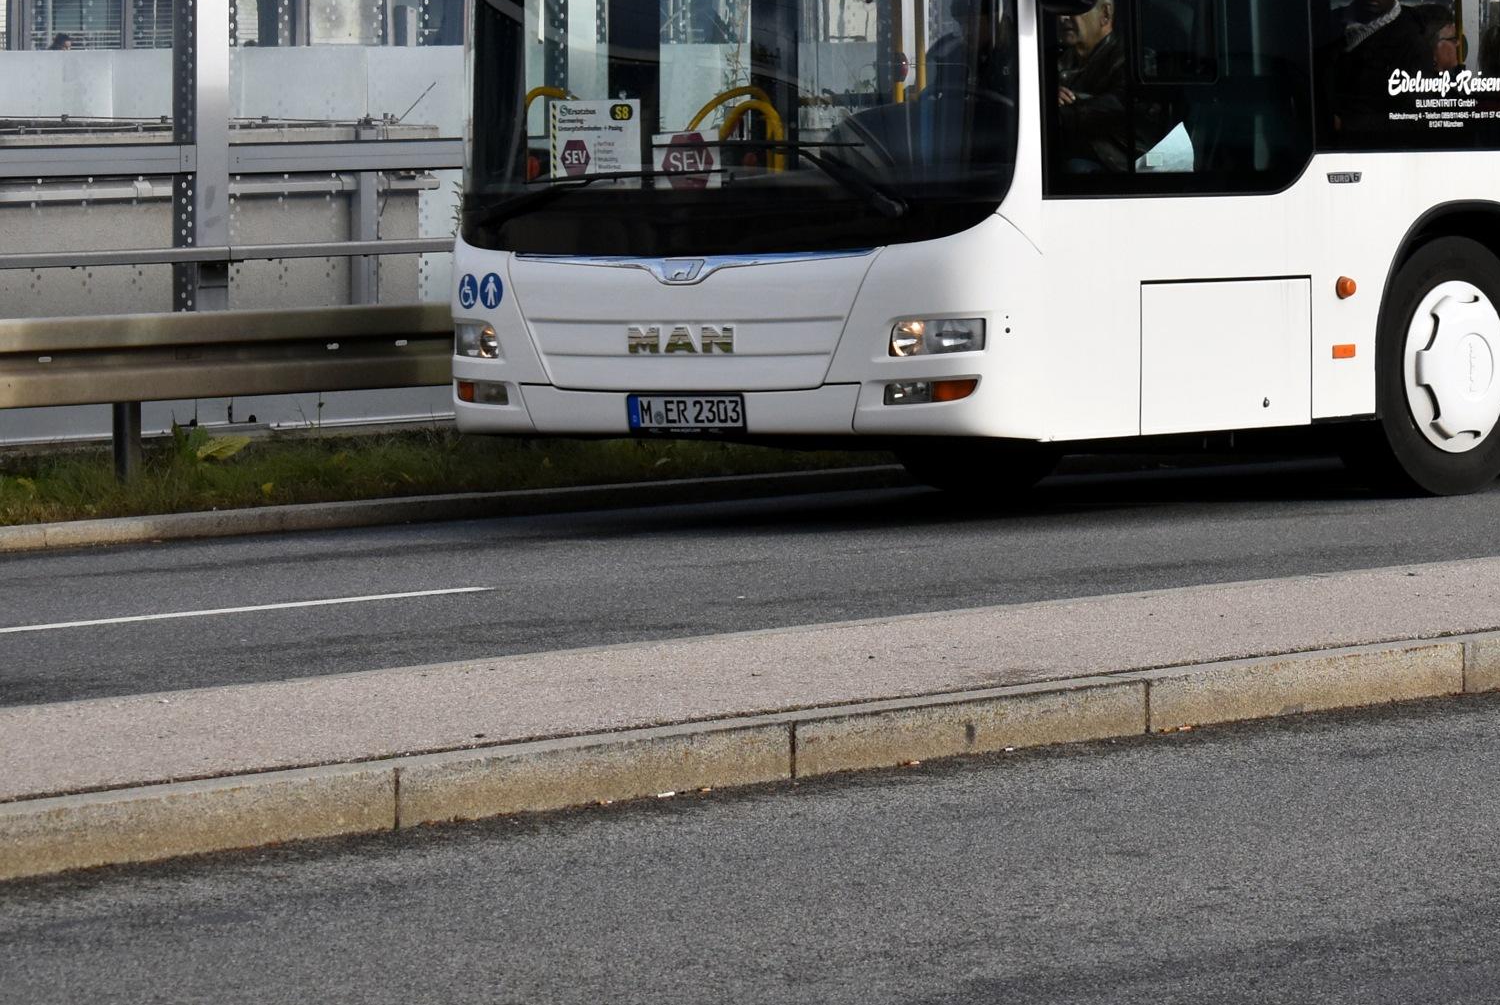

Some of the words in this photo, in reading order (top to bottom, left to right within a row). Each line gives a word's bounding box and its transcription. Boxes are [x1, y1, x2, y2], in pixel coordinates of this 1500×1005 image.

[1388, 68, 1500, 97] Edelweiß-Reisen
[1415, 99, 1457, 108] BLUMENTRITT
[1457, 98, 1476, 108] GmbH
[614, 106, 629, 120] S8
[564, 150, 587, 164] SEV
[669, 149, 706, 172] SEV
[1329, 174, 1350, 182] EURO
[627, 324, 736, 354] MAN
[639, 399, 653, 424] M
[664, 399, 689, 424] ER
[692, 399, 741, 424] 2303
